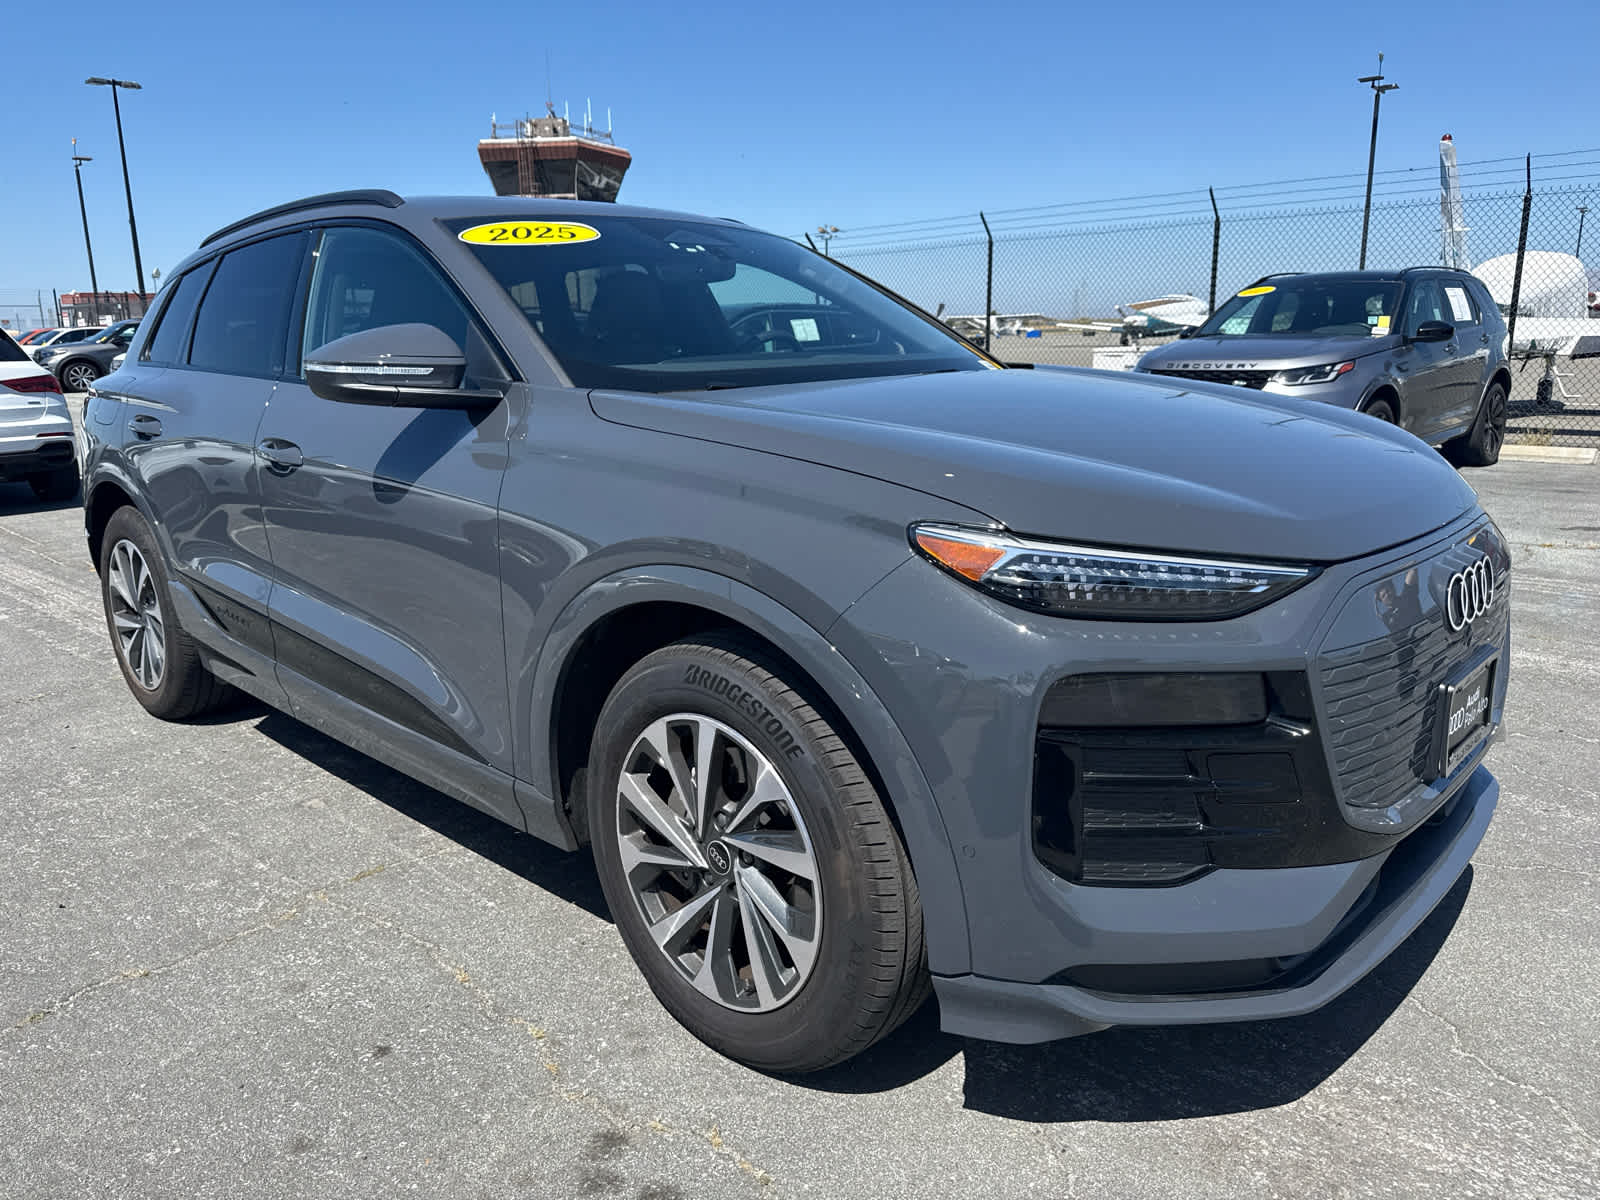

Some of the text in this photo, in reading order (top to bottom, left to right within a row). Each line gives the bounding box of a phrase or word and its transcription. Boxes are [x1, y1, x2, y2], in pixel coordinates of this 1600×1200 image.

[489, 226, 576, 242] 2025
[1466, 685, 1481, 708] Audi
[684, 664, 805, 760] BRIDGESTONE
